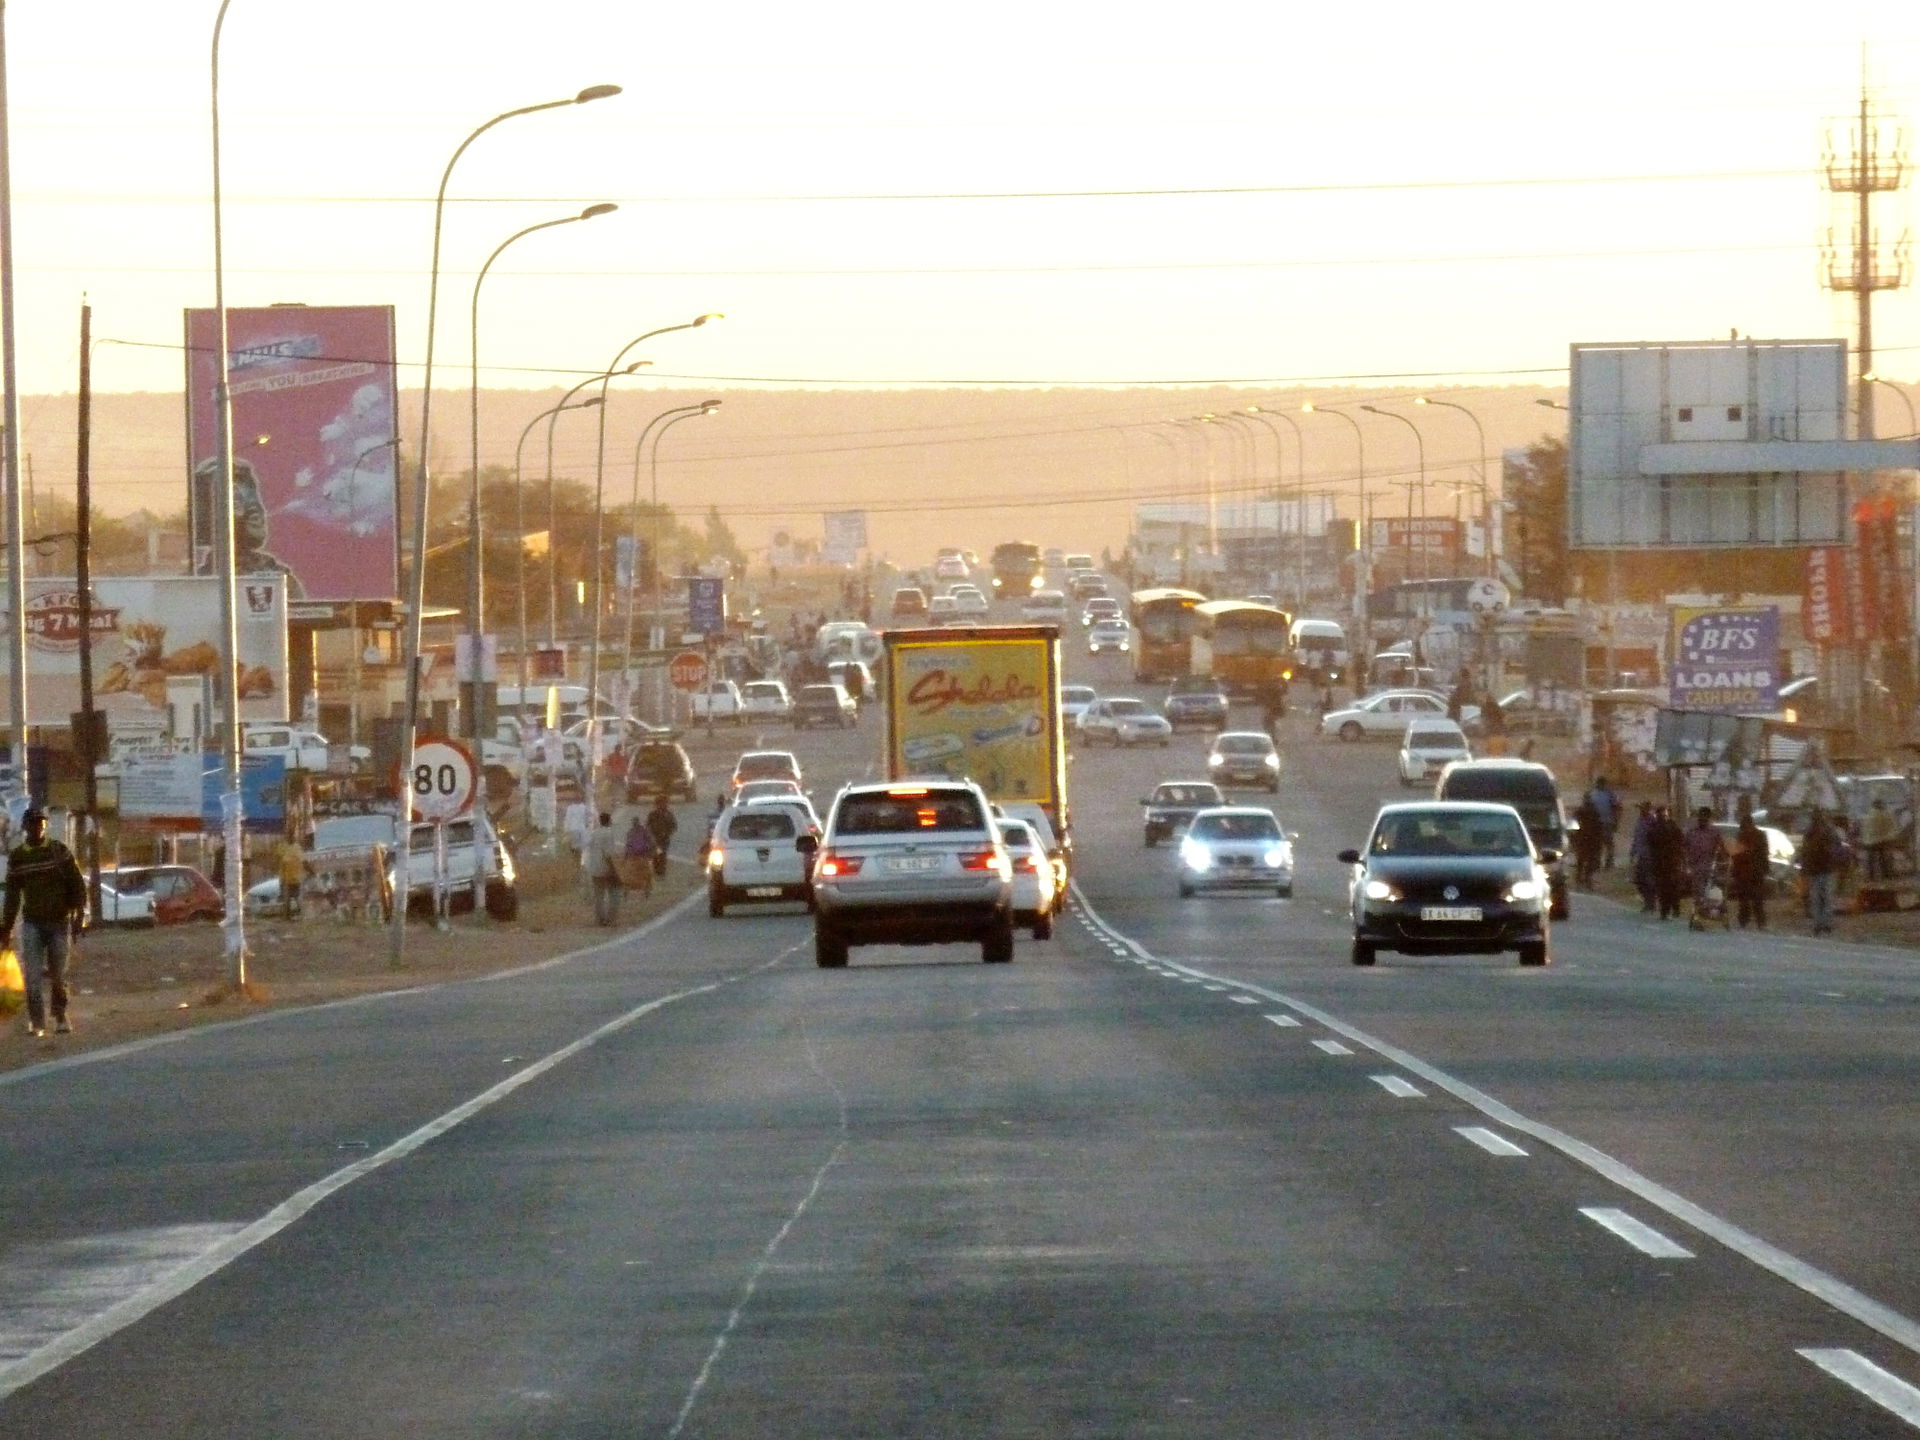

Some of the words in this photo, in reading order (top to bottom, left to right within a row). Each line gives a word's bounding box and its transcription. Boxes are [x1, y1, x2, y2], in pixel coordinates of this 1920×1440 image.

[48, 613, 63, 631] 7
[66, 612, 112, 629] Mal
[1700, 628, 1759, 649] BFS
[673, 665, 706, 682] STOP
[1676, 671, 1771, 688] LOANS
[414, 764, 456, 795] 80
